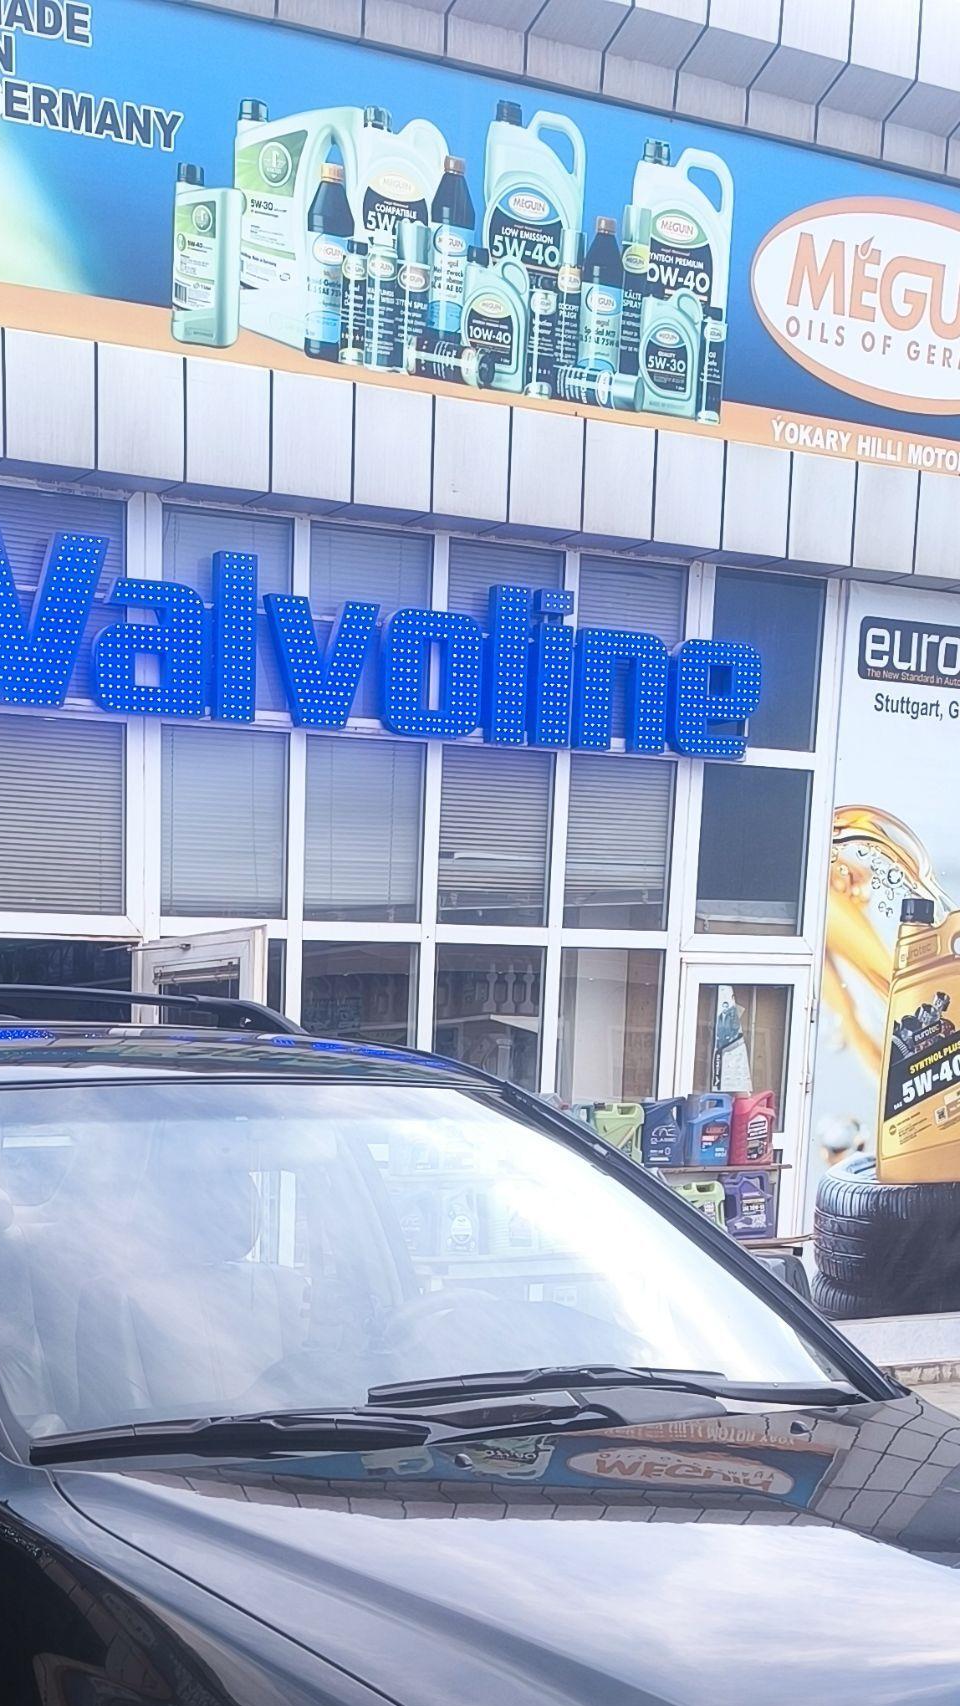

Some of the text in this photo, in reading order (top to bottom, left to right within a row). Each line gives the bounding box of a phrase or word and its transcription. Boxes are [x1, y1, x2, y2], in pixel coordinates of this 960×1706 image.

[375, 203, 417, 219] COMPATIBLE
[501, 226, 519, 238] LOW
[520, 230, 554, 245] EMISSION
[660, 219, 694, 235] MEGUIN
[491, 234, 560, 268] 5W-40
[649, 251, 673, 264] YNTECH
[468, 325, 512, 344] 10W-40
[785, 316, 960, 370] OILS OF GER
[647, 356, 687, 373] 5W-30
[771, 415, 960, 473] ÝOKARY HILLI MOTO
[867, 668, 881, 679] The
[882, 670, 900, 680] New
[901, 672, 935, 685] Standard
[936, 675, 943, 684] in
[874, 692, 943, 721] Stuttgart,
[913, 1022, 941, 1042] eurotec
[909, 1040, 960, 1075] SYNTHOL PLUS
